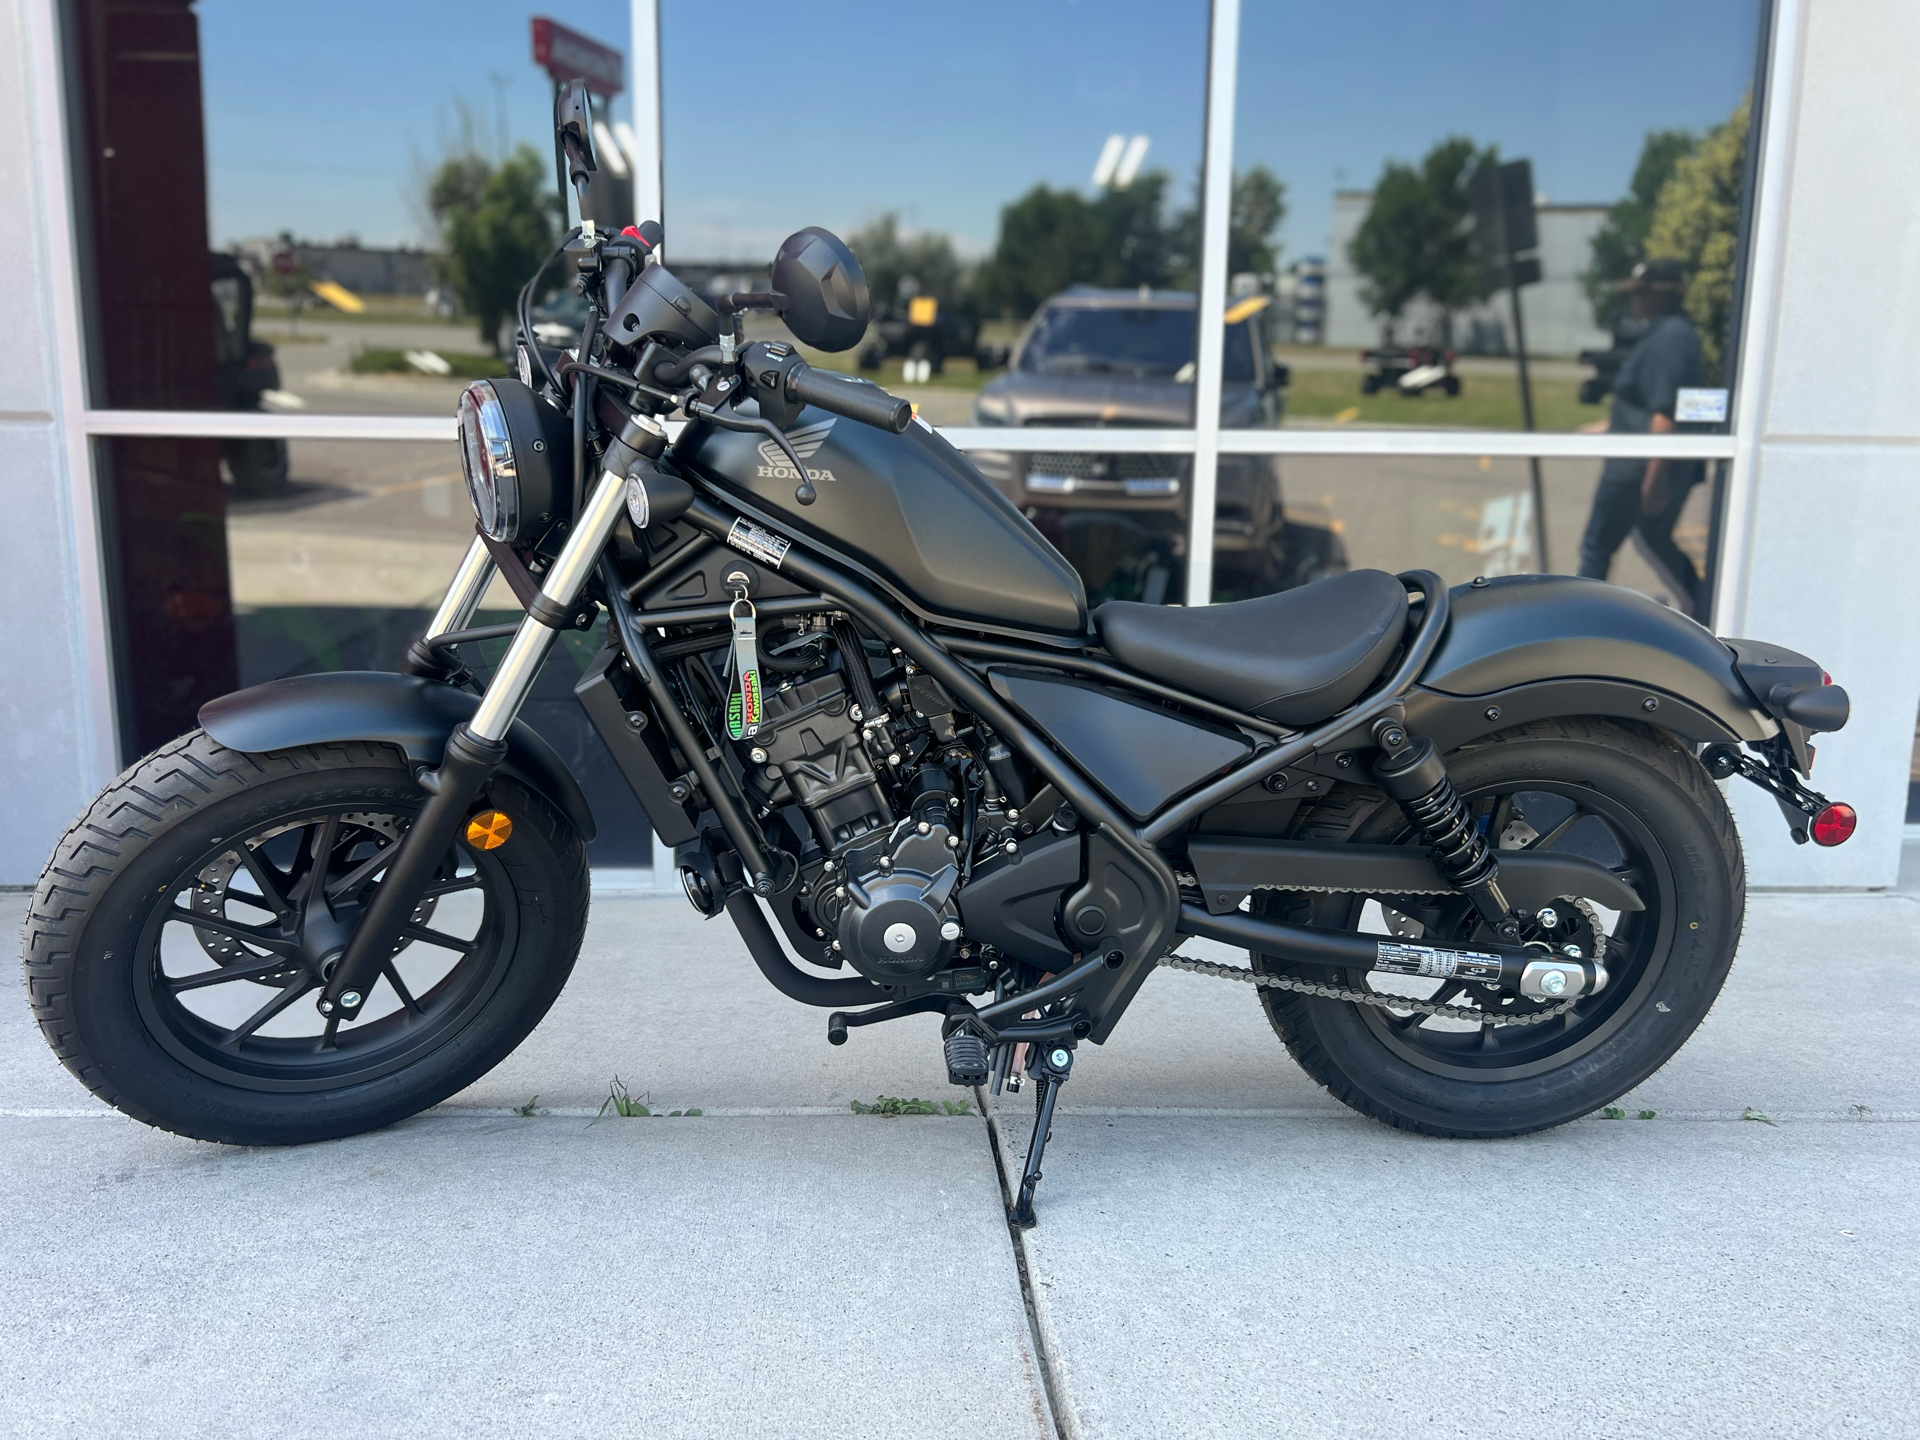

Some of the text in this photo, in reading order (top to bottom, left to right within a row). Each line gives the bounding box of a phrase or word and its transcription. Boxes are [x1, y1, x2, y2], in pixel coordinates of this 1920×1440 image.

[757, 466, 836, 482] HONDA
[743, 671, 753, 724] HONDA
[748, 670, 760, 723] Kawasaki
[913, 684, 947, 707] KEIHIN
[876, 956, 925, 964] HONDA
